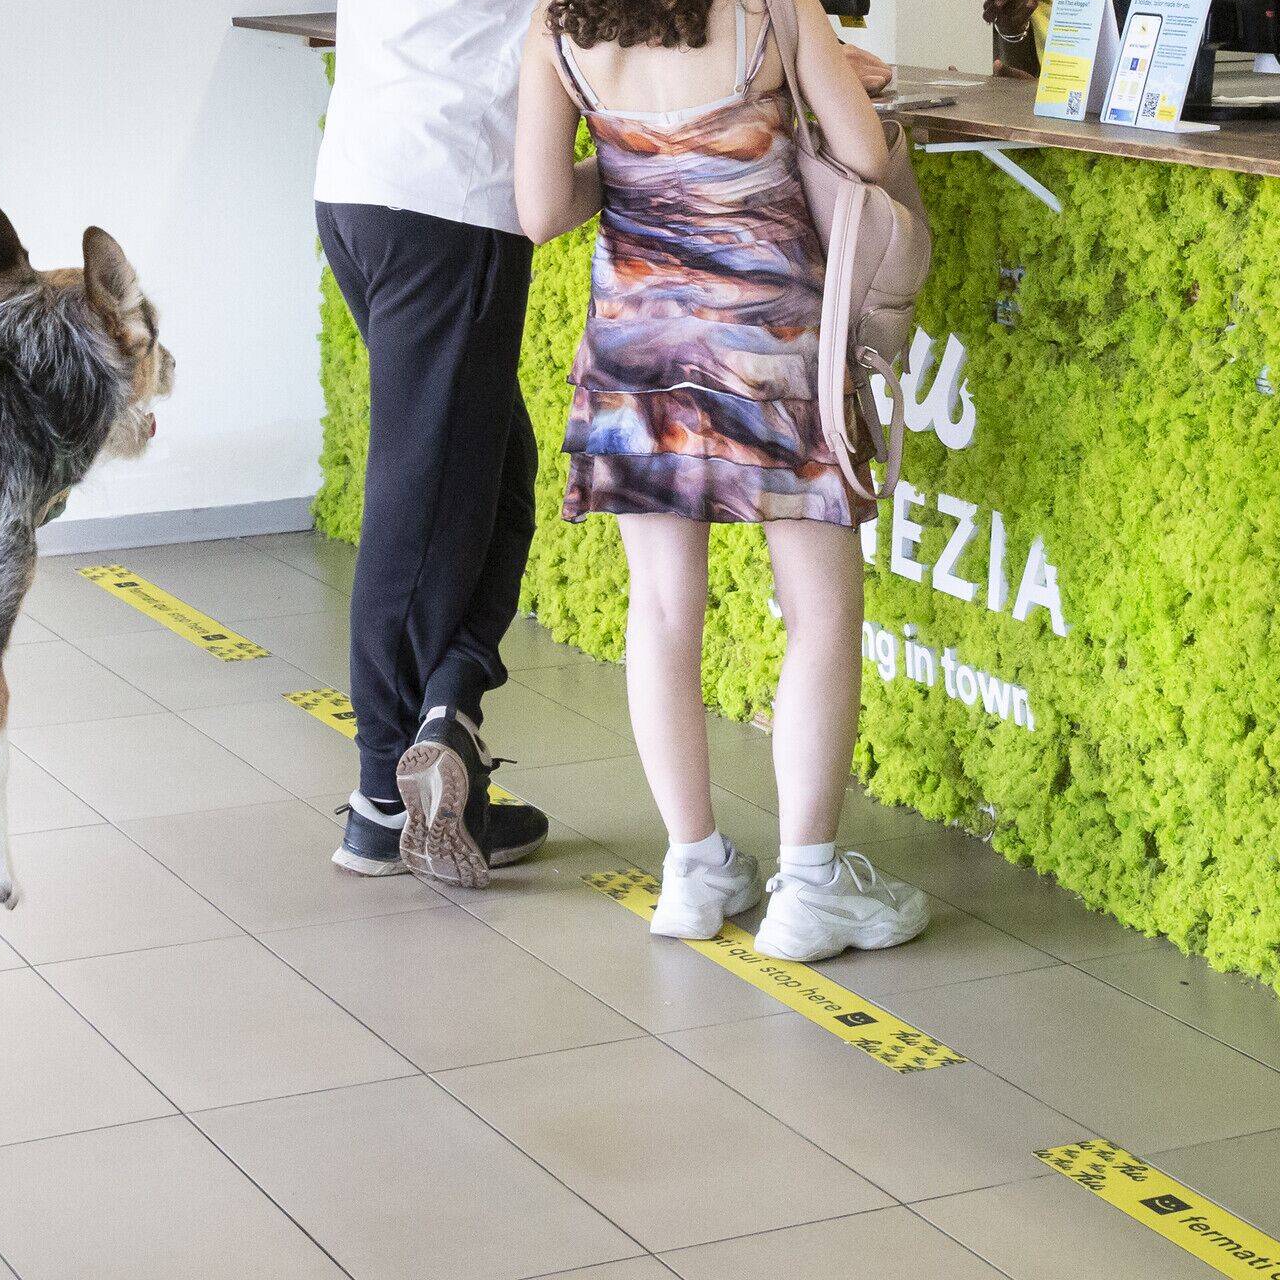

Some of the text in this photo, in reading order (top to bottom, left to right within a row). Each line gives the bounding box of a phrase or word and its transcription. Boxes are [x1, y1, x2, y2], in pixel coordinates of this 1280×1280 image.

[905, 623, 934, 687] in
[942, 647, 1035, 732] town
[728, 948, 769, 963] qui
[760, 966, 803, 988] stop
[797, 987, 843, 1013] here
